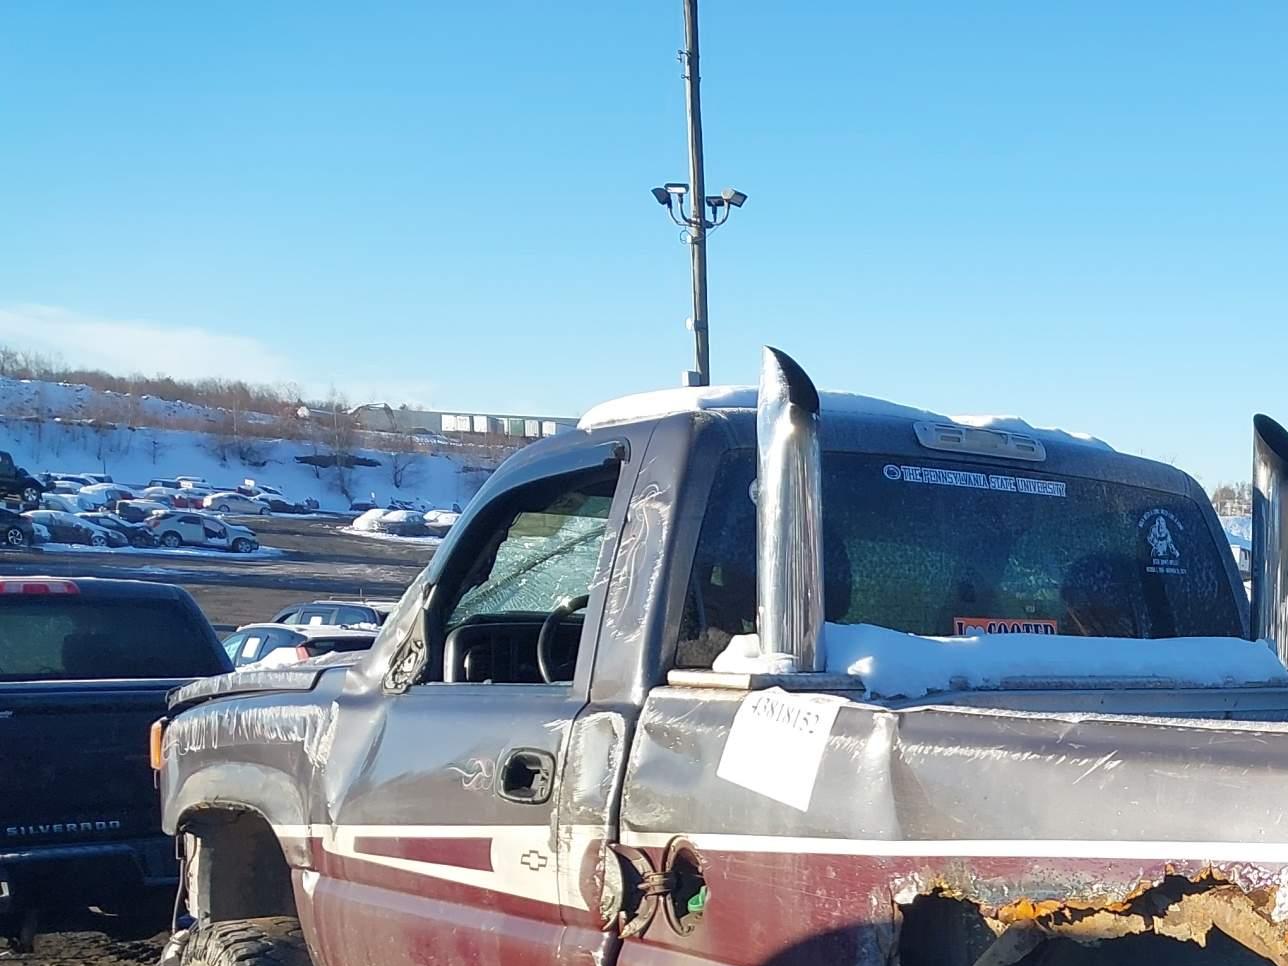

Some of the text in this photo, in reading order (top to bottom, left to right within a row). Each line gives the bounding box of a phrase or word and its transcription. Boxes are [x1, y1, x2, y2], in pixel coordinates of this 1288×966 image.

[901, 466, 1066, 497] THE PENNSYLVANIA STATE UNIVERSITY
[6, 820, 120, 836] SILVERADO
